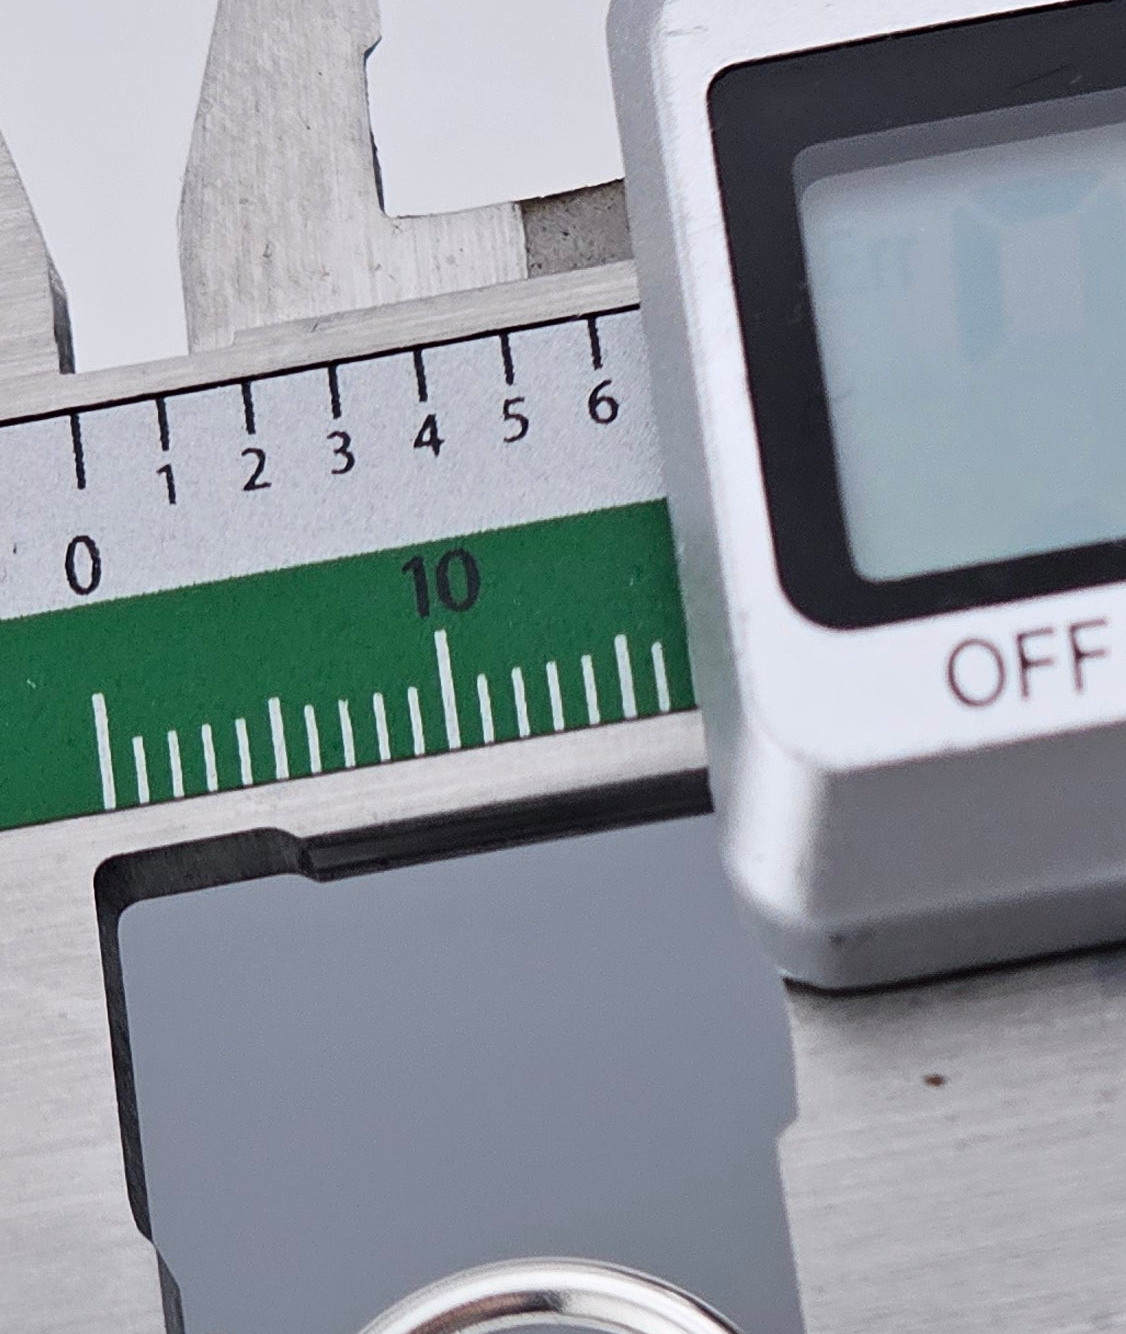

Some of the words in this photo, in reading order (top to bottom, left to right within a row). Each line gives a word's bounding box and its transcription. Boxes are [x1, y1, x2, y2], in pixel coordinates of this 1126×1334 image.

[157, 465, 177, 505] 1
[241, 448, 272, 491] 2
[328, 431, 356, 475] 3
[413, 414, 445, 457] 4
[502, 398, 530, 443] 5
[588, 380, 619, 425] 6
[64, 535, 102, 595] 0
[402, 547, 482, 617] 10
[947, 617, 1114, 709] OFF
